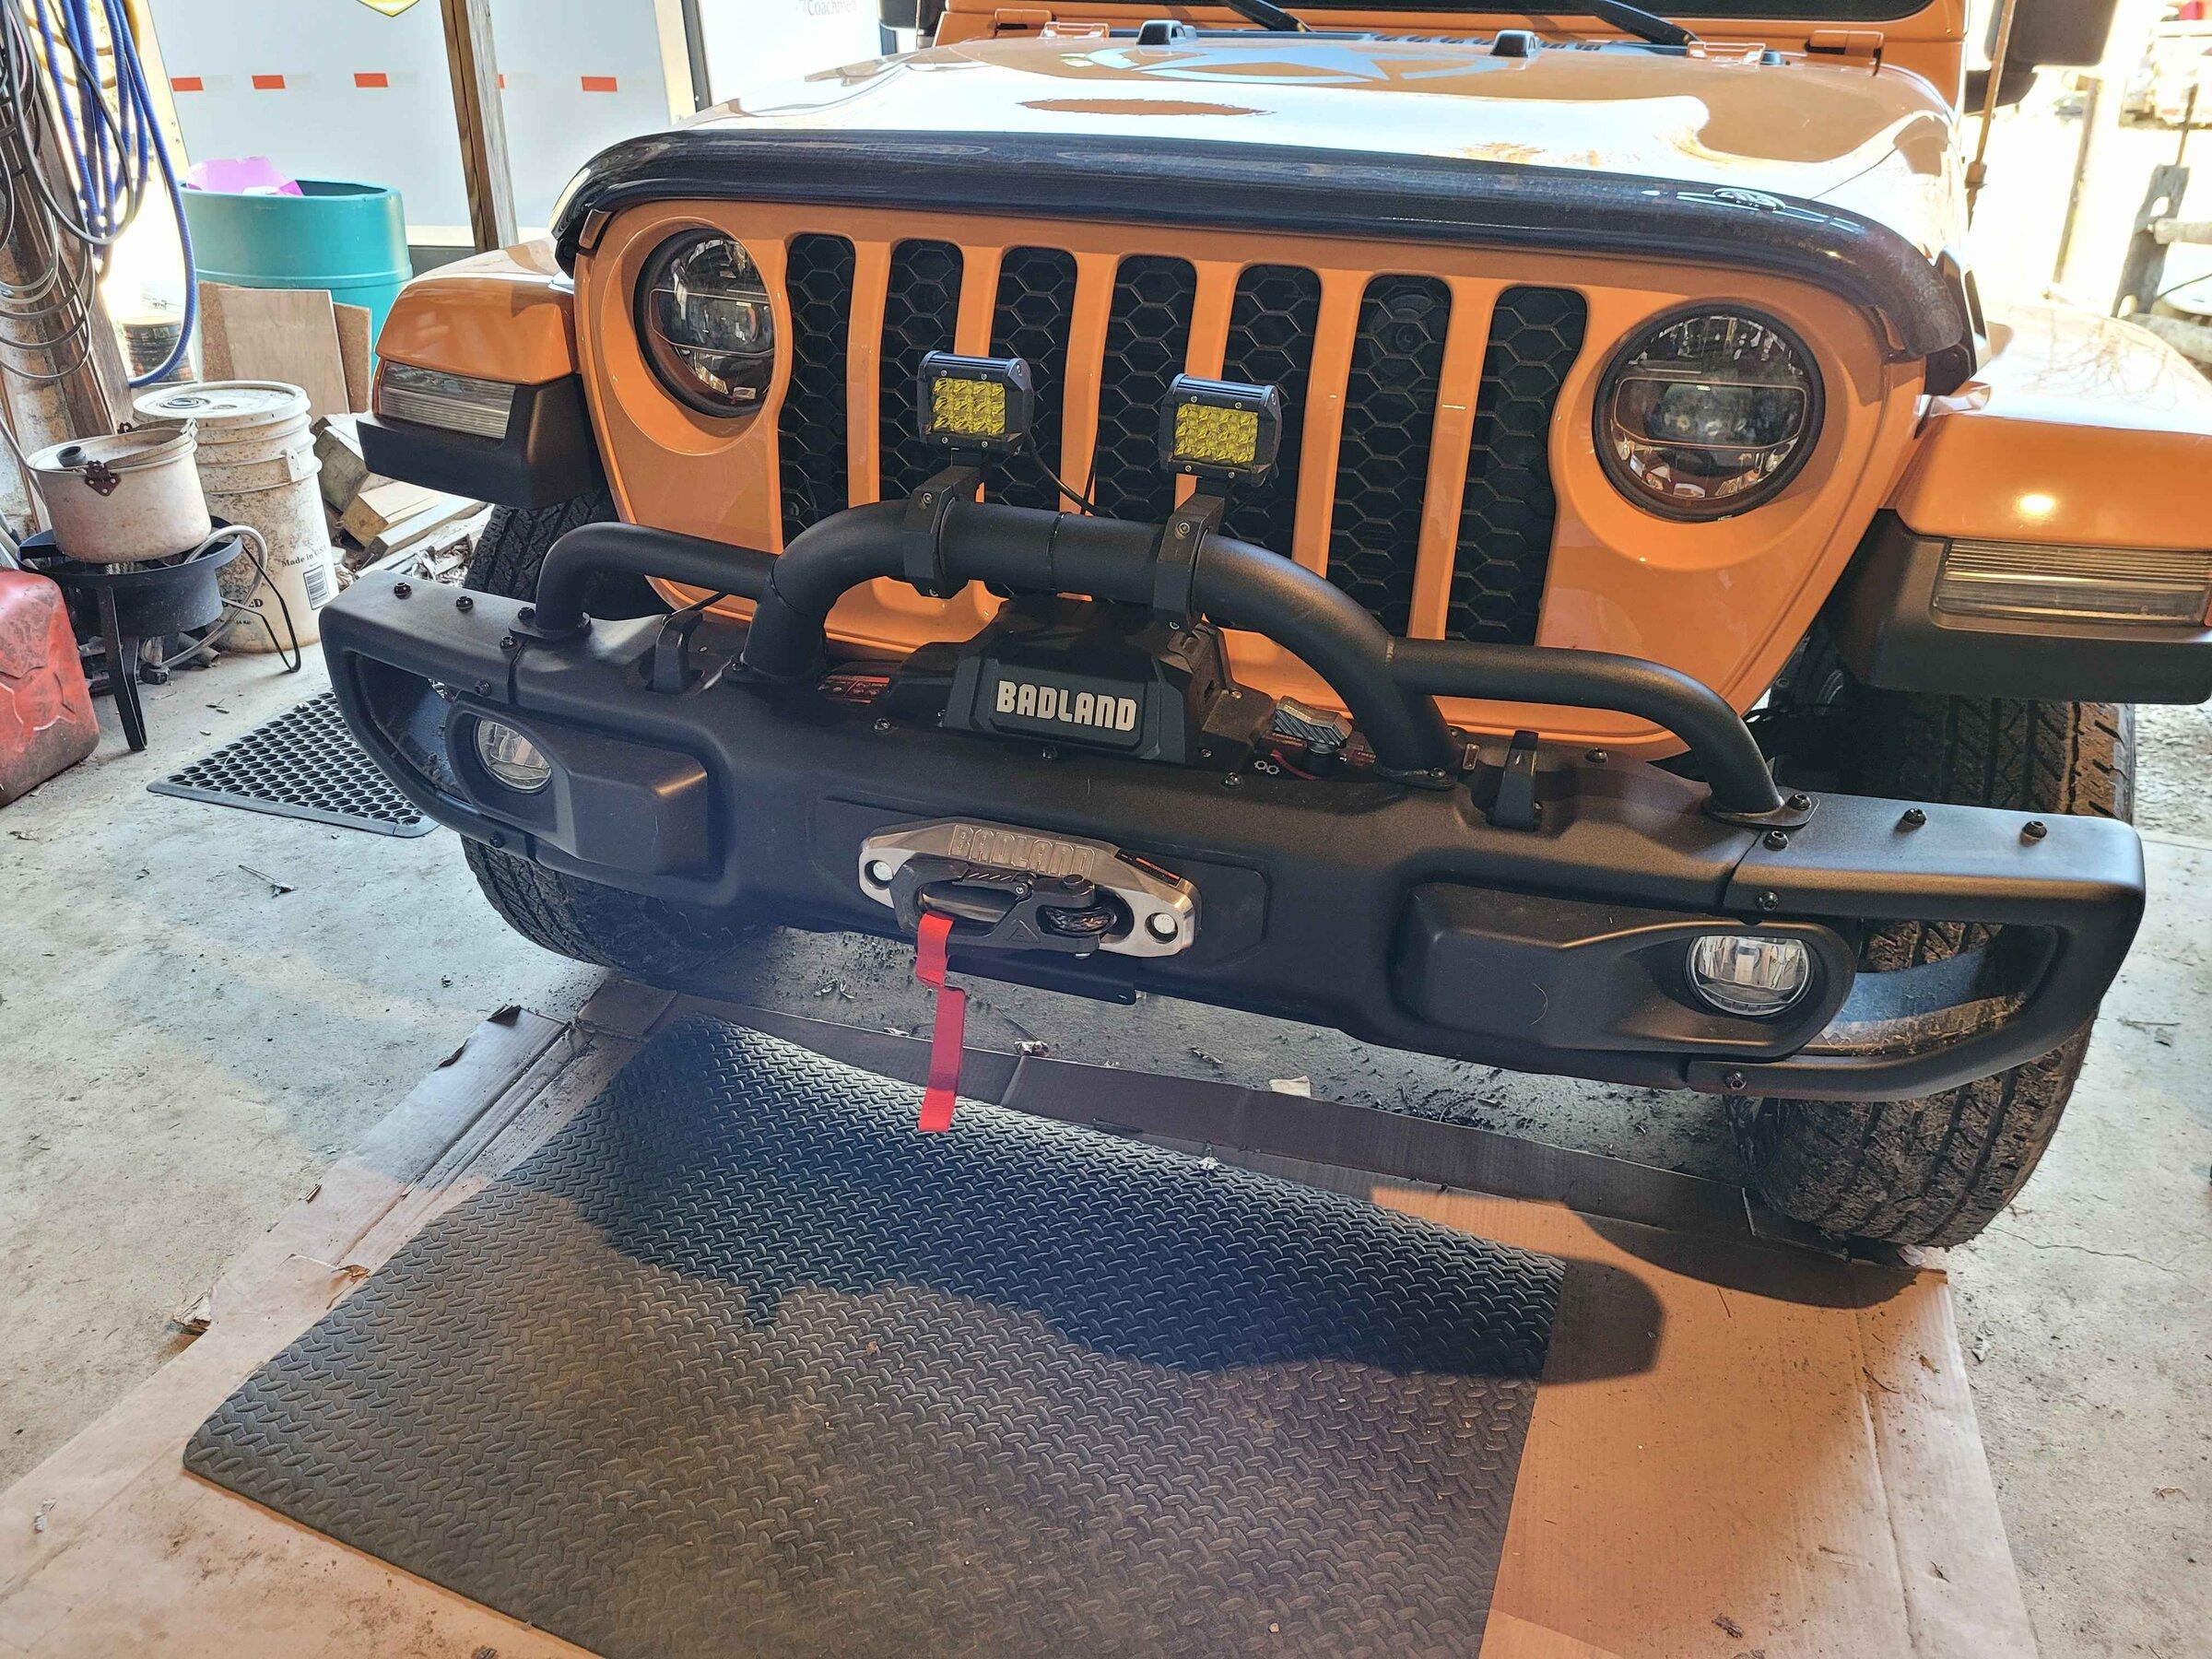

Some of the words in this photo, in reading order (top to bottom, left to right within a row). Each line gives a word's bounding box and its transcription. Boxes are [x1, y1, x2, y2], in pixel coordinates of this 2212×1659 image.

[280, 556, 305, 568] Made
[996, 680, 1137, 732] BADLAND
[947, 824, 1095, 878] BADLAND
